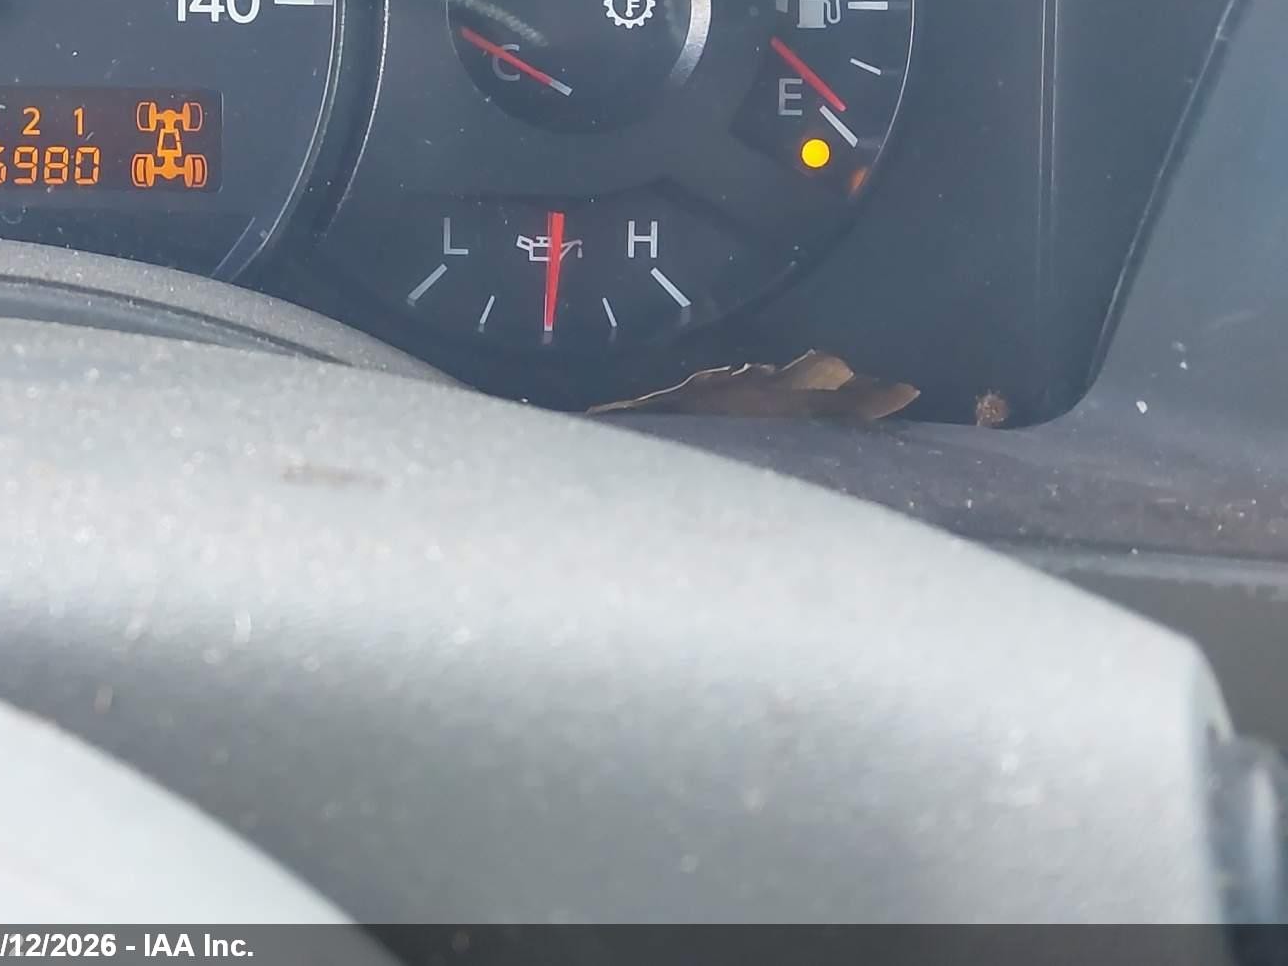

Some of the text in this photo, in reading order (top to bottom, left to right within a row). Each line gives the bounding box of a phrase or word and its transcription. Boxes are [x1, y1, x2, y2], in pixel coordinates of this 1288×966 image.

[492, 43, 521, 81] C
[778, 77, 803, 116] E
[22, 107, 41, 136] 2
[74, 107, 83, 136] 1
[443, 217, 469, 255] L
[627, 220, 658, 259] H
